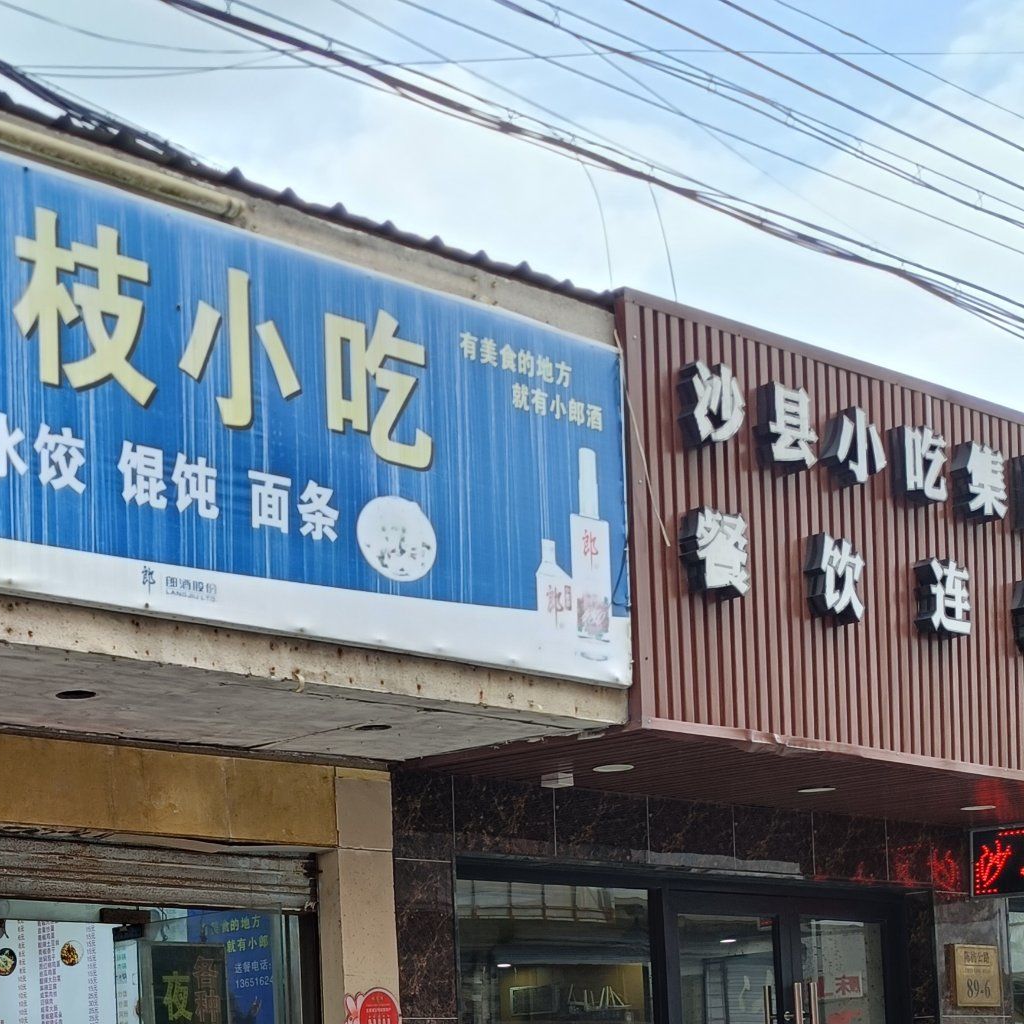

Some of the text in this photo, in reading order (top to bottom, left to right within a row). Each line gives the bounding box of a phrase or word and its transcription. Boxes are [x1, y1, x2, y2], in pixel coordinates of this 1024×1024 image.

[459, 331, 572, 389] 有美食的地方
[511, 381, 604, 432] 就有小郎酒
[117, 440, 220, 520] 馄饨
[247, 469, 341, 544] 面条
